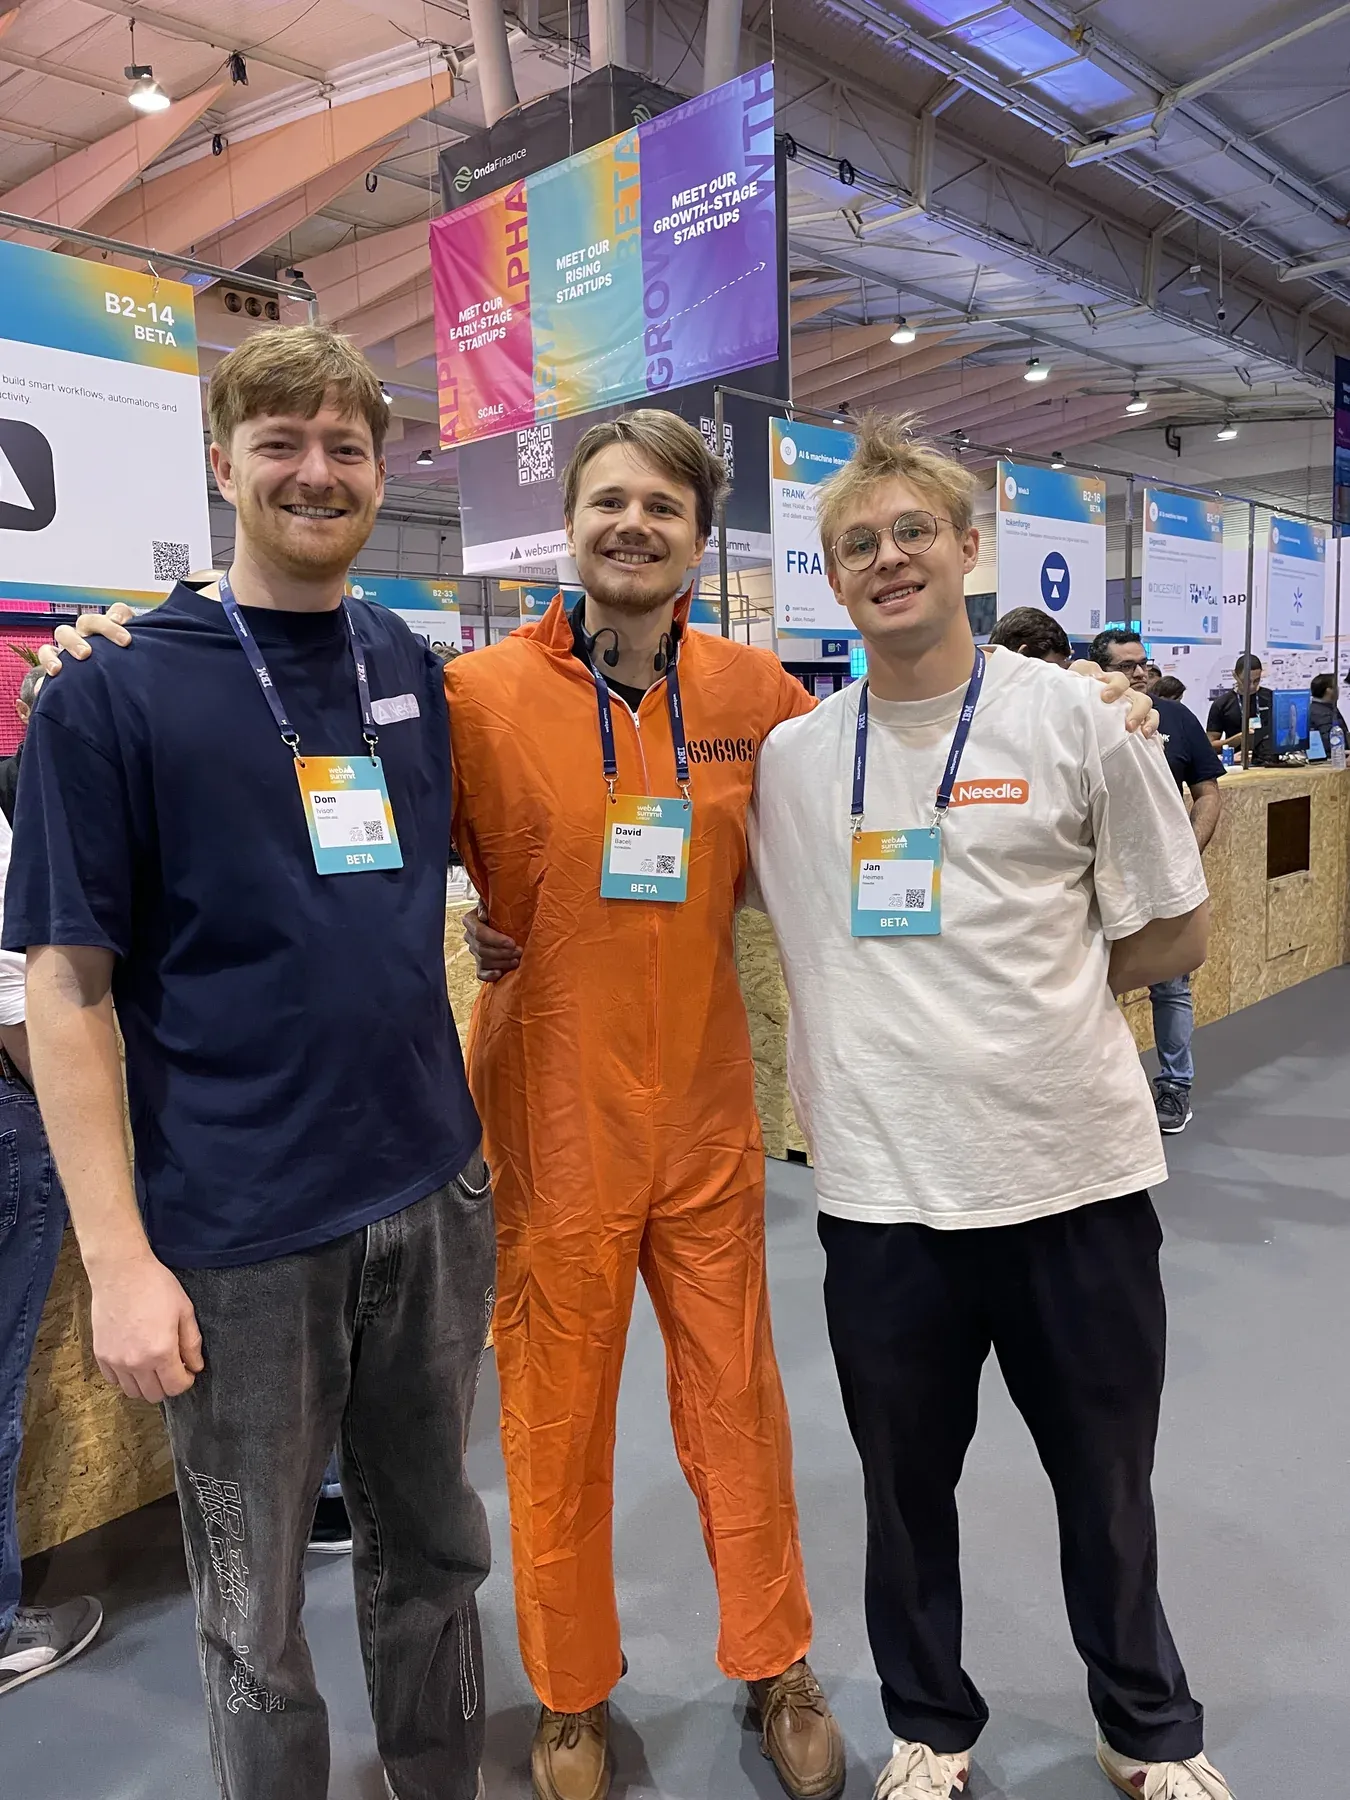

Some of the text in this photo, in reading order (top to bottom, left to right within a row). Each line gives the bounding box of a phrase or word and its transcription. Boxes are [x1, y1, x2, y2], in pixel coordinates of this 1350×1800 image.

[473, 147, 527, 180] OndaFinance
[671, 171, 737, 210] MEET OUR
[653, 181, 758, 235] GROWTH-STAGE
[673, 208, 741, 246] STARTUPS
[556, 239, 610, 271] MEET OUR
[565, 260, 601, 284] RISING
[556, 273, 613, 304] STARTUPS
[104, 291, 175, 327] B2-14
[458, 296, 503, 324] MEET OUR
[449, 309, 513, 341] EARLY-STAGE
[134, 324, 177, 348] BETA
[458, 327, 507, 352] STARTUPS
[2, 374, 178, 413] build smart workflows, automations and
[477, 403, 504, 419] SCALE
[782, 487, 806, 500] FRANK
[524, 541, 568, 558] websumm
[786, 549, 827, 576] FRA
[256, 666, 273, 688] IBM
[356, 662, 367, 683] IBM
[961, 704, 975, 723] IBM
[677, 746, 687, 765] IBM
[686, 738, 756, 764] 696969
[328, 765, 344, 774] web
[330, 773, 356, 781] summit
[314, 795, 337, 804] Dom
[958, 783, 1023, 802] Needle
[636, 810, 663, 818] summit
[615, 827, 642, 837] David
[881, 836, 897, 844] web
[881, 842, 908, 850] summit
[346, 853, 375, 865] BETA
[863, 863, 881, 872] Jan
[630, 883, 658, 894] BETA
[880, 917, 909, 928] BETA
